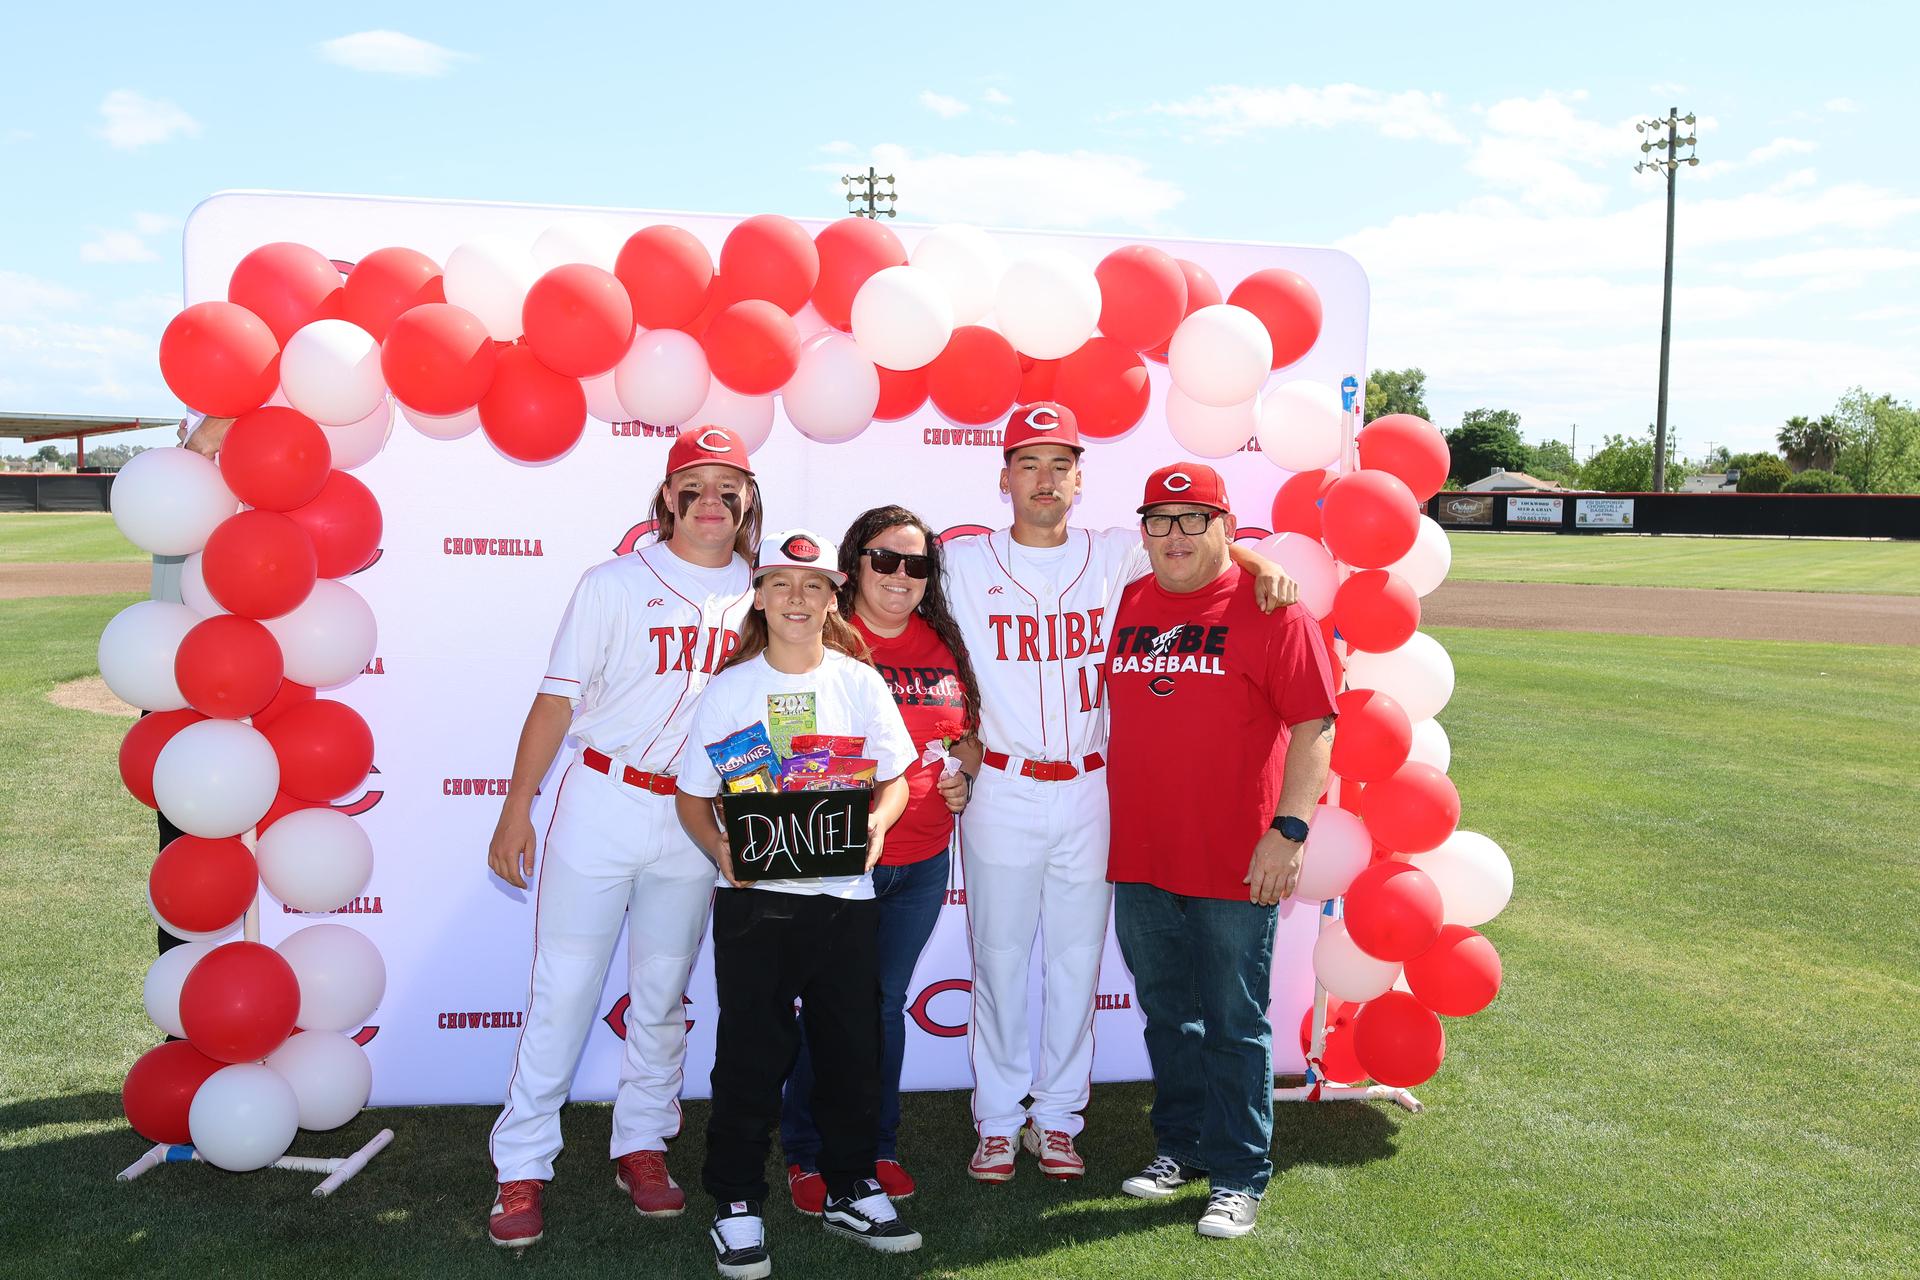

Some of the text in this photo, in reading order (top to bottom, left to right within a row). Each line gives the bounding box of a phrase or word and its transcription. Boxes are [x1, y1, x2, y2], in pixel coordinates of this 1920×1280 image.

[612, 420, 681, 437] CHOWCH
[923, 428, 1004, 446] CHOWCHILL
[443, 537, 544, 557] CHOWCHILLA
[988, 607, 1105, 662] TRIBE
[1112, 655, 1226, 676] BASEBALL
[443, 778, 513, 796] CHOWCH
[738, 799, 867, 873] DANIEL
[438, 1011, 523, 1030] CHOWCHILL
